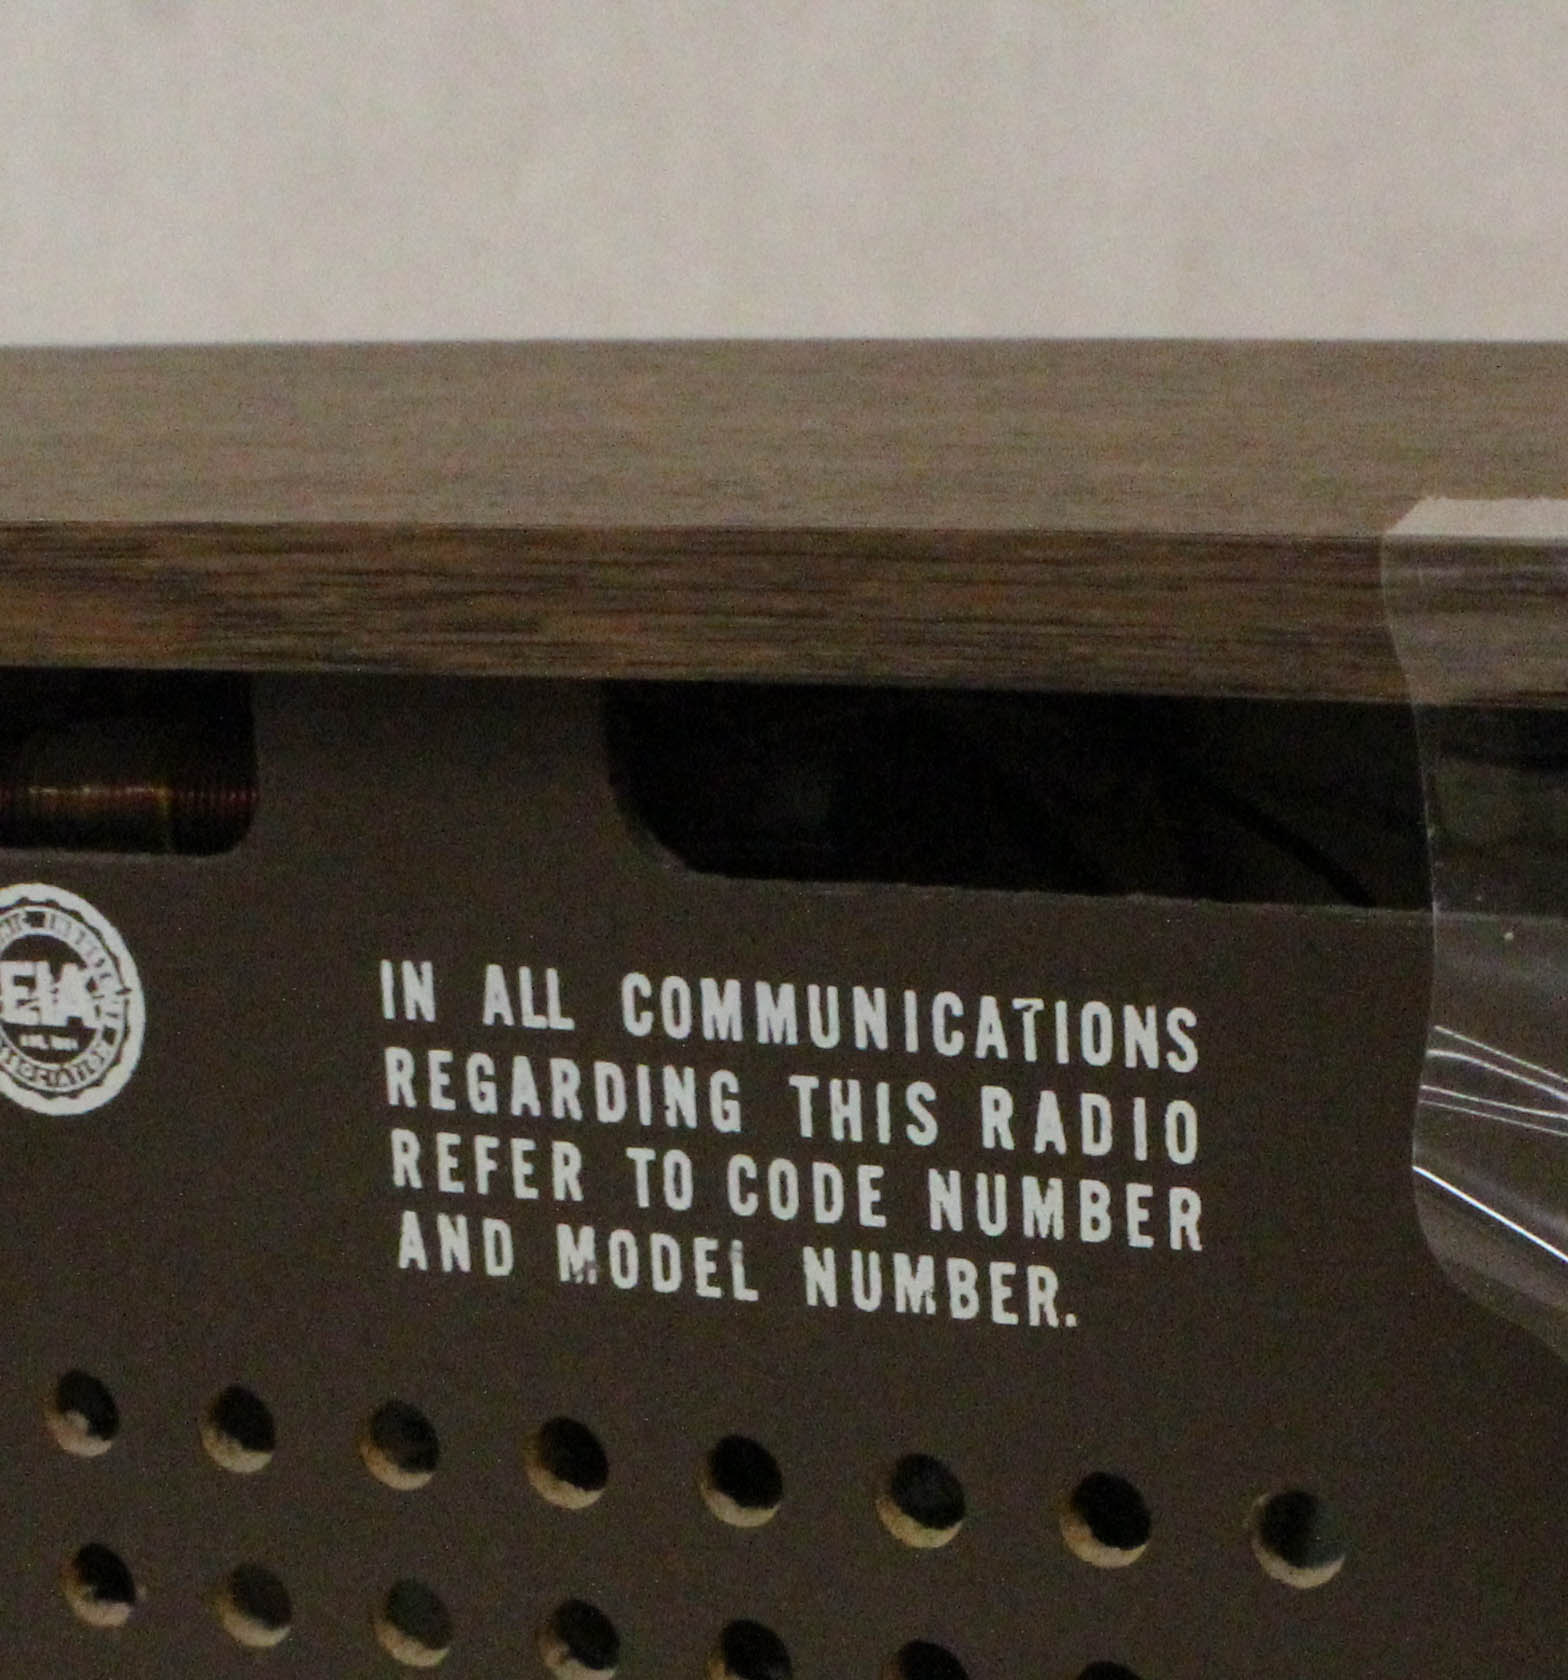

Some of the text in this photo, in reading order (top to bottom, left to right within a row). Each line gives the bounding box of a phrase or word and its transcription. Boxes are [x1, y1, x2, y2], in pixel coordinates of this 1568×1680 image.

[379, 959, 1198, 1073] IN ALL COMMUNICATIONS
[384, 1046, 1197, 1164] REGARDING THIS RADIO
[389, 1129, 1202, 1252] REFER TO CODE NUMBER
[397, 1210, 1078, 1328] AND MODEL NUMBER.
